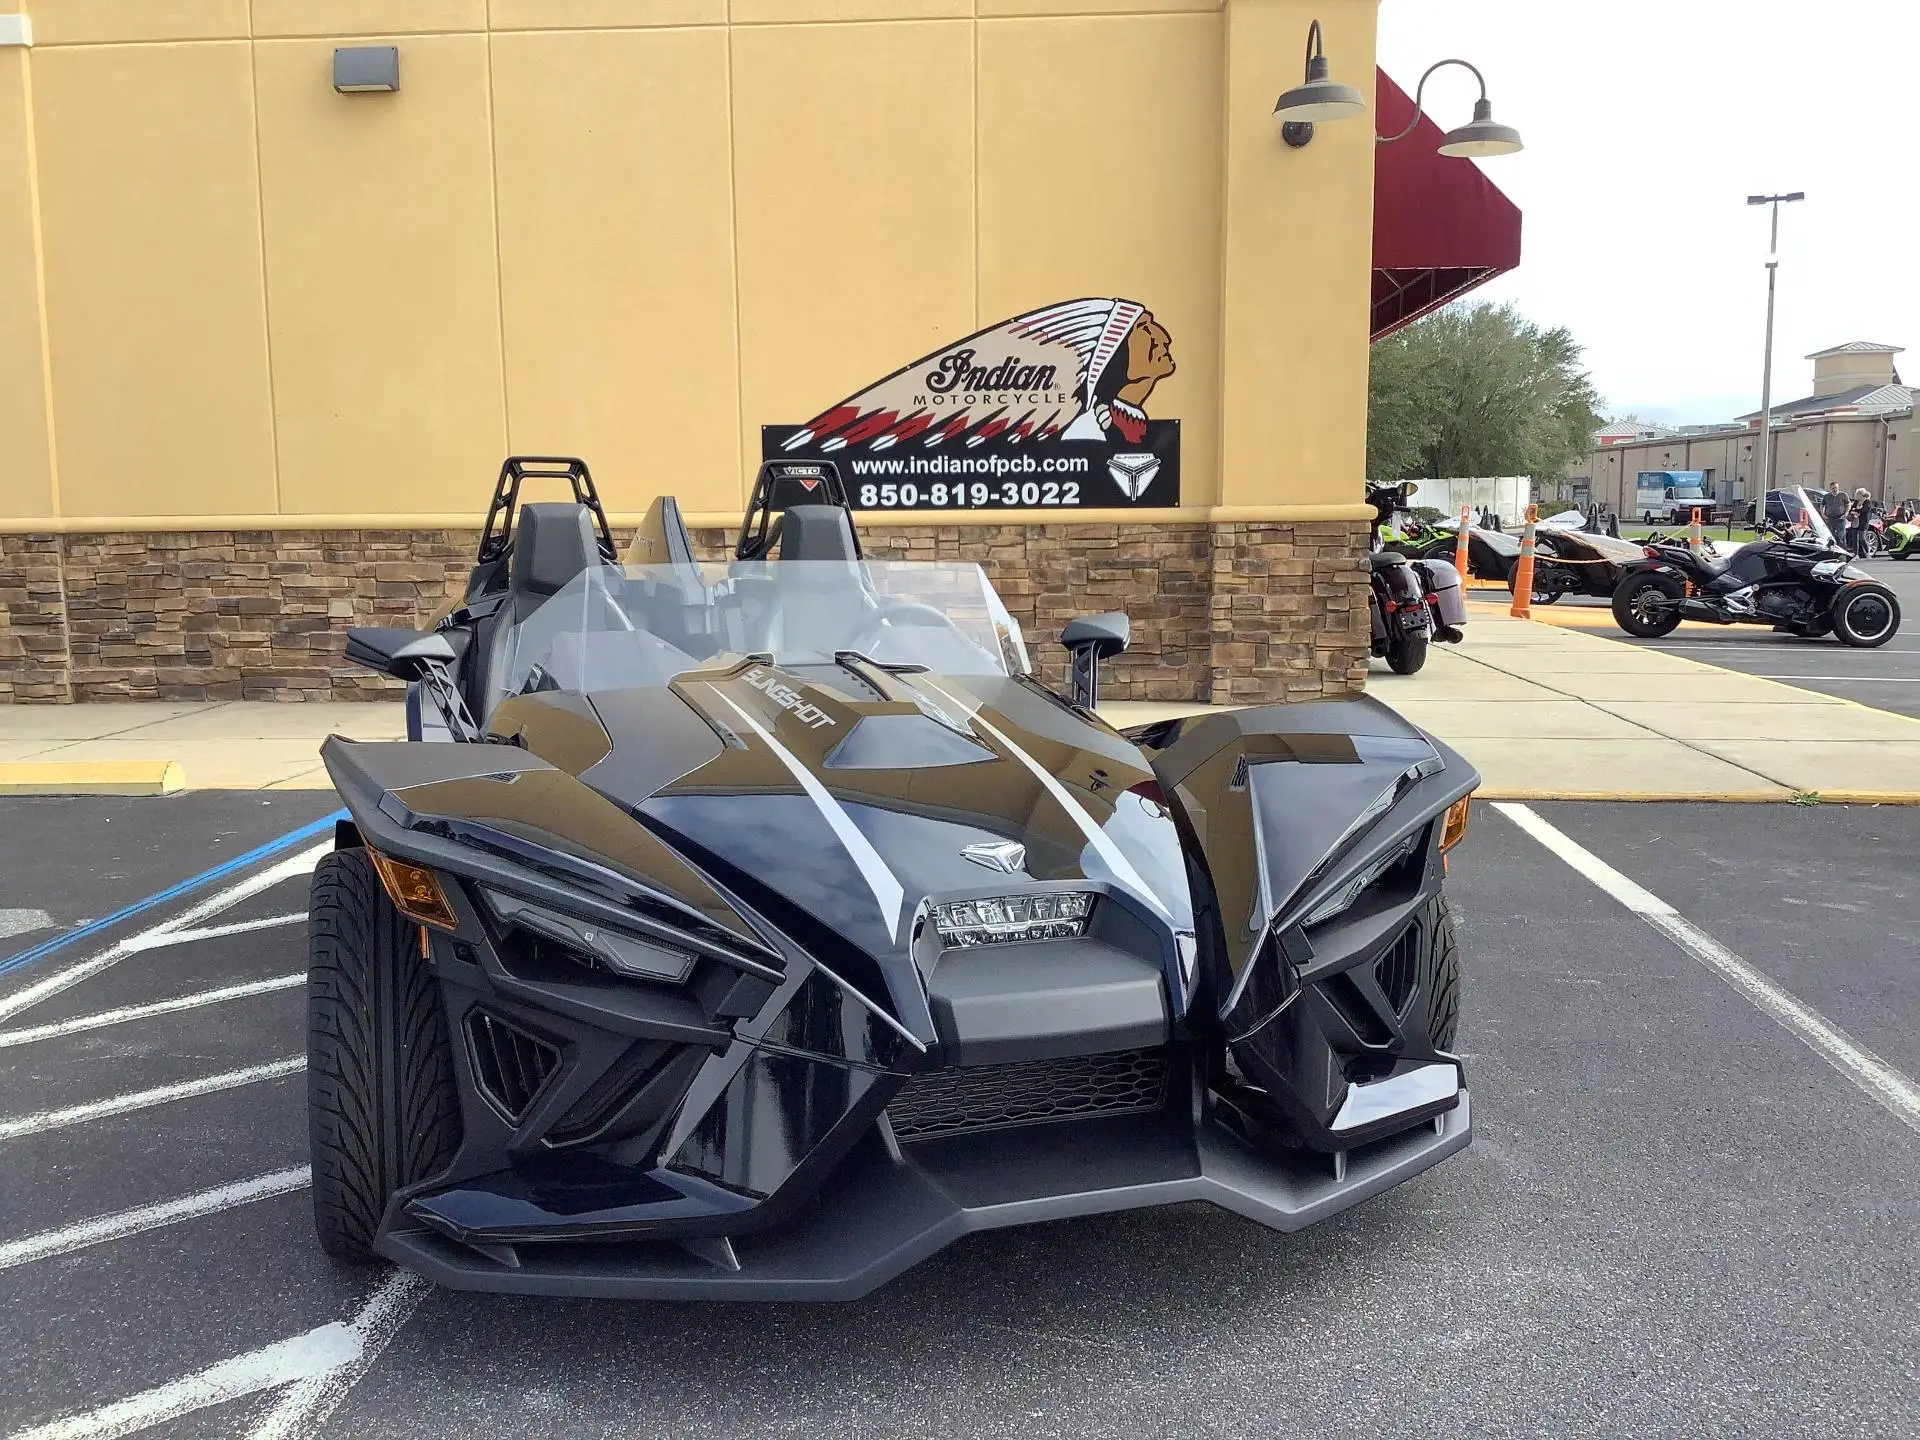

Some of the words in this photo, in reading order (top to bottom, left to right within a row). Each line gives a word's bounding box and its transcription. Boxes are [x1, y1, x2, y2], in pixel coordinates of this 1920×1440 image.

[926, 349, 1057, 394] Indian
[913, 393, 1066, 406] MOTORCYCLE
[784, 467, 820, 475] VICTO
[851, 455, 1089, 477] www.indianofpcb.com
[860, 482, 1081, 507] 850-819-3022
[742, 669, 837, 729] SLINGSHOT
